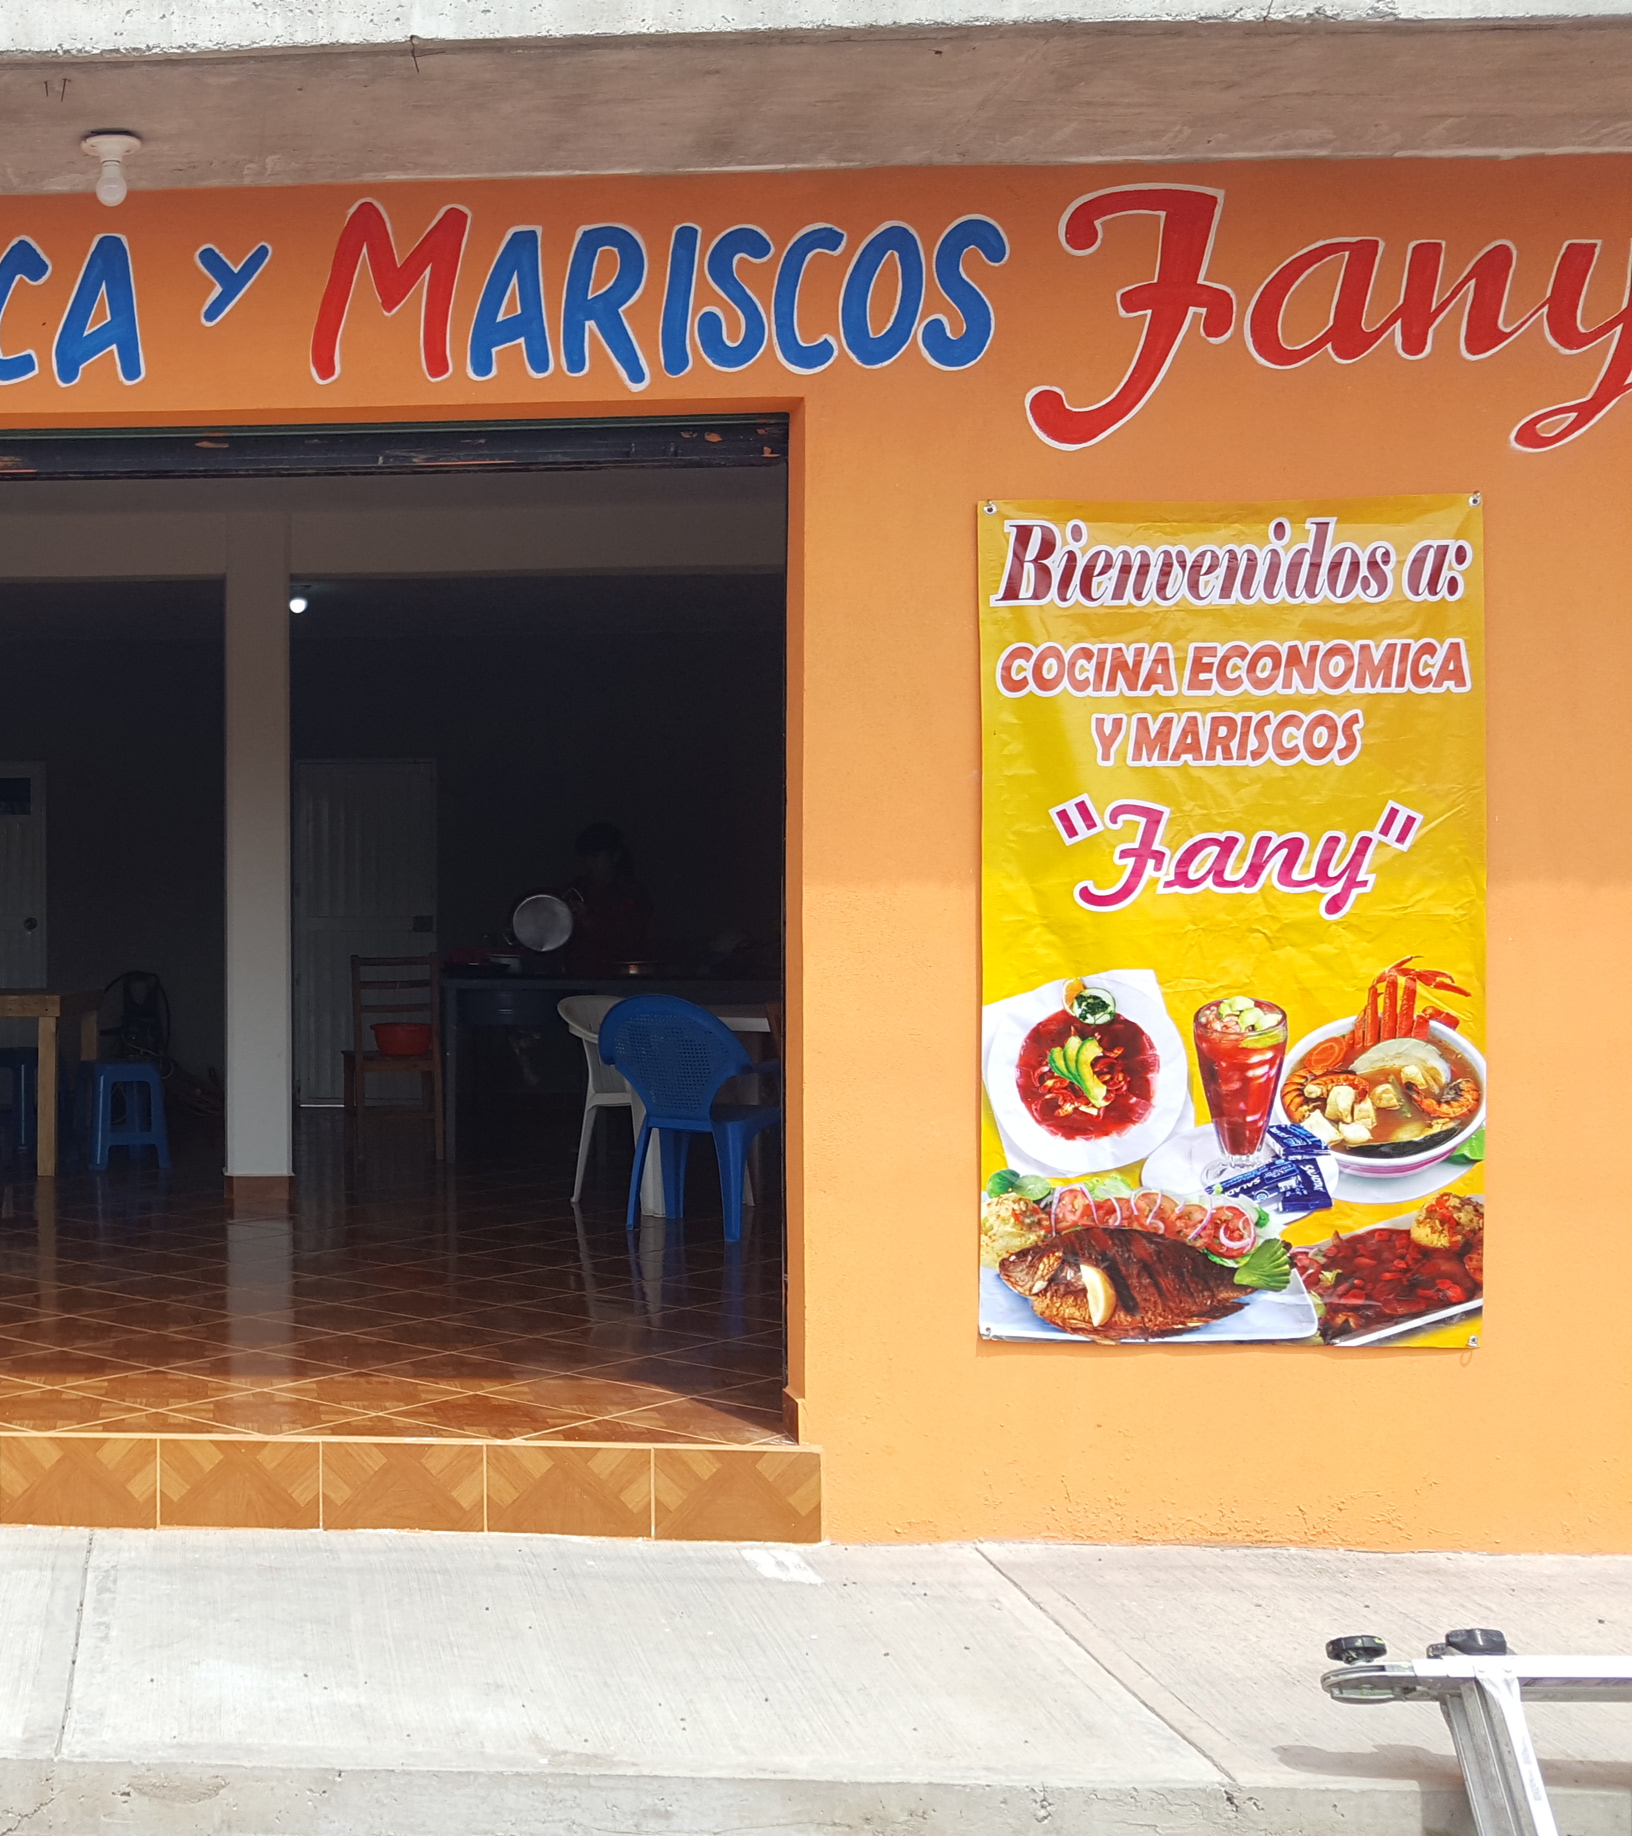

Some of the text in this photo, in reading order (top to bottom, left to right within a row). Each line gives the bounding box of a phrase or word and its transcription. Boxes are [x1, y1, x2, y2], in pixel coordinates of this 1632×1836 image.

[310, 198, 1009, 388] MARISCOS
[1025, 183, 1632, 450] Fany
[990, 518, 1473, 607] Bienvenidos a:
[997, 640, 1470, 696] COCINA ECONOMICA
[1091, 710, 1362, 766] Y MARISCOS
